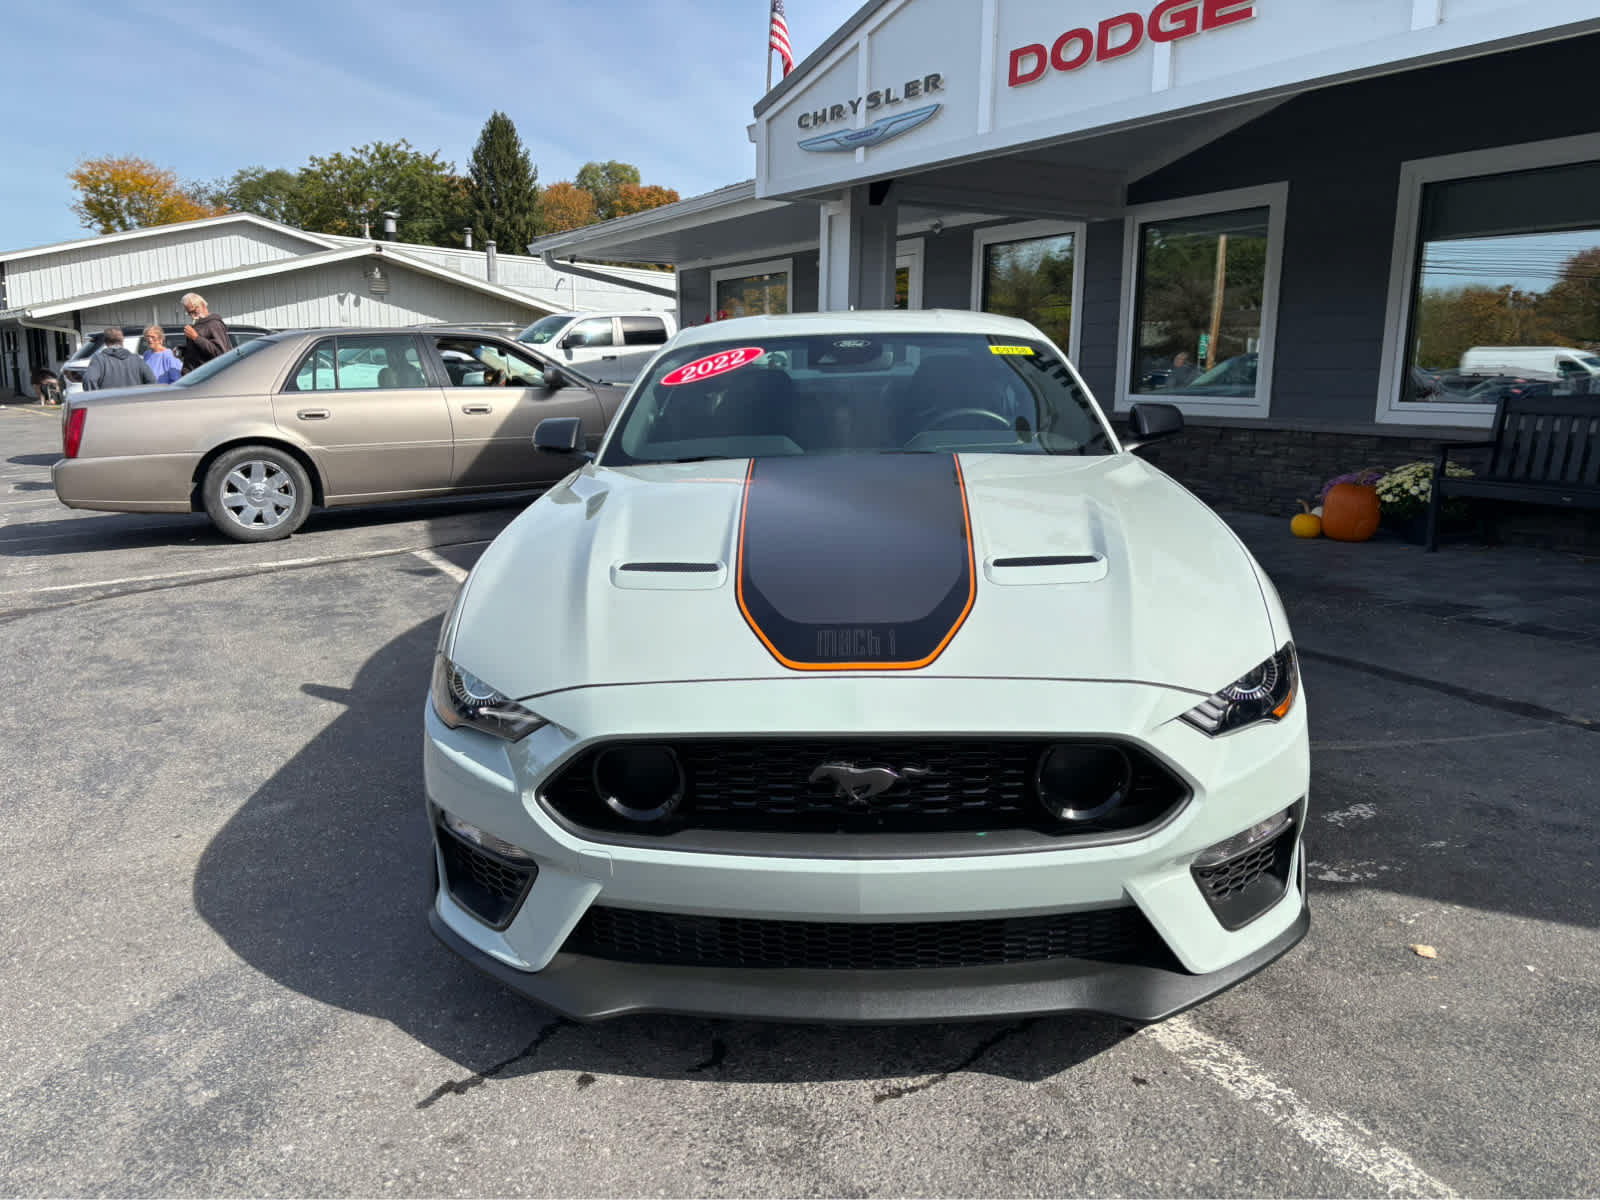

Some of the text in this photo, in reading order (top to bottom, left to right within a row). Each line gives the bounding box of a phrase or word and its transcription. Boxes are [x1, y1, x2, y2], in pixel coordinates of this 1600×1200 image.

[1008, 0, 1254, 87] DODGE
[798, 73, 943, 129] CHRYSLER
[681, 350, 744, 382] 2022
